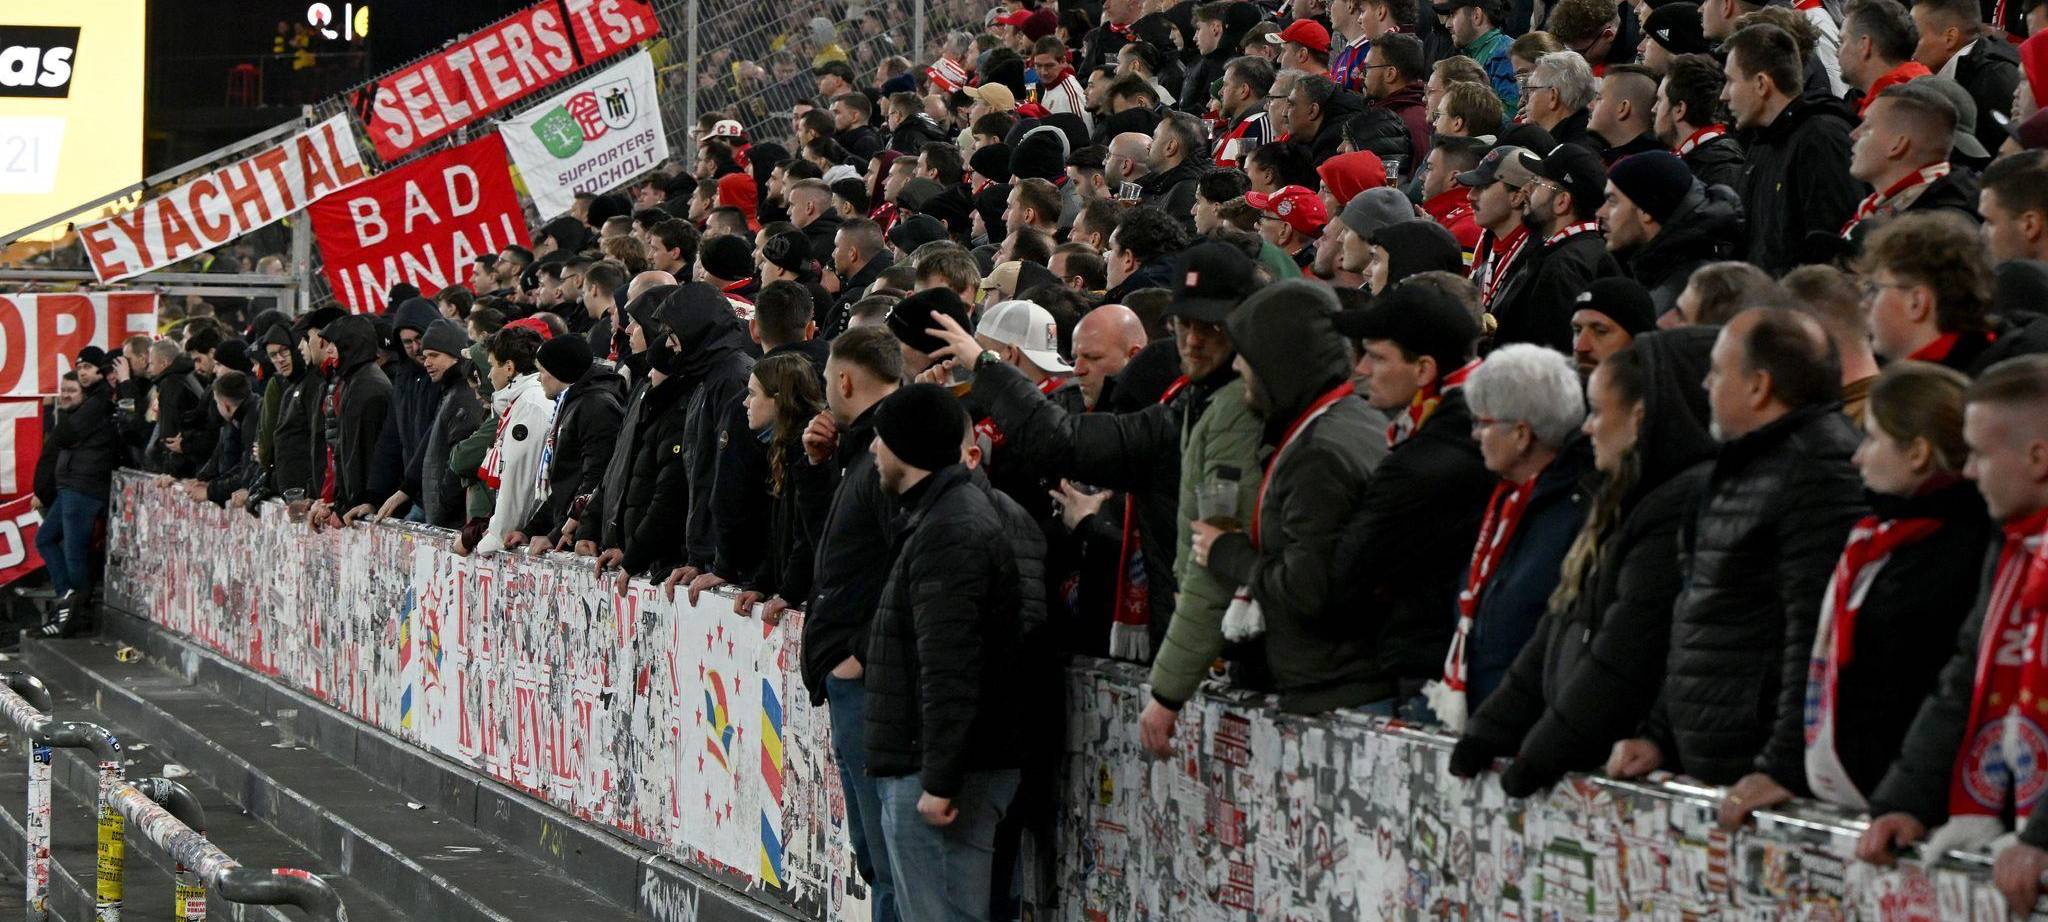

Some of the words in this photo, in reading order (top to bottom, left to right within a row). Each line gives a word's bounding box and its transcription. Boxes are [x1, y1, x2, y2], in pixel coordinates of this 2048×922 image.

[373, 9, 573, 151] SELTERS
[81, 123, 366, 281] EYACHTAL
[348, 164, 480, 248] BAD
[558, 129, 656, 187] SUPPORTERS
